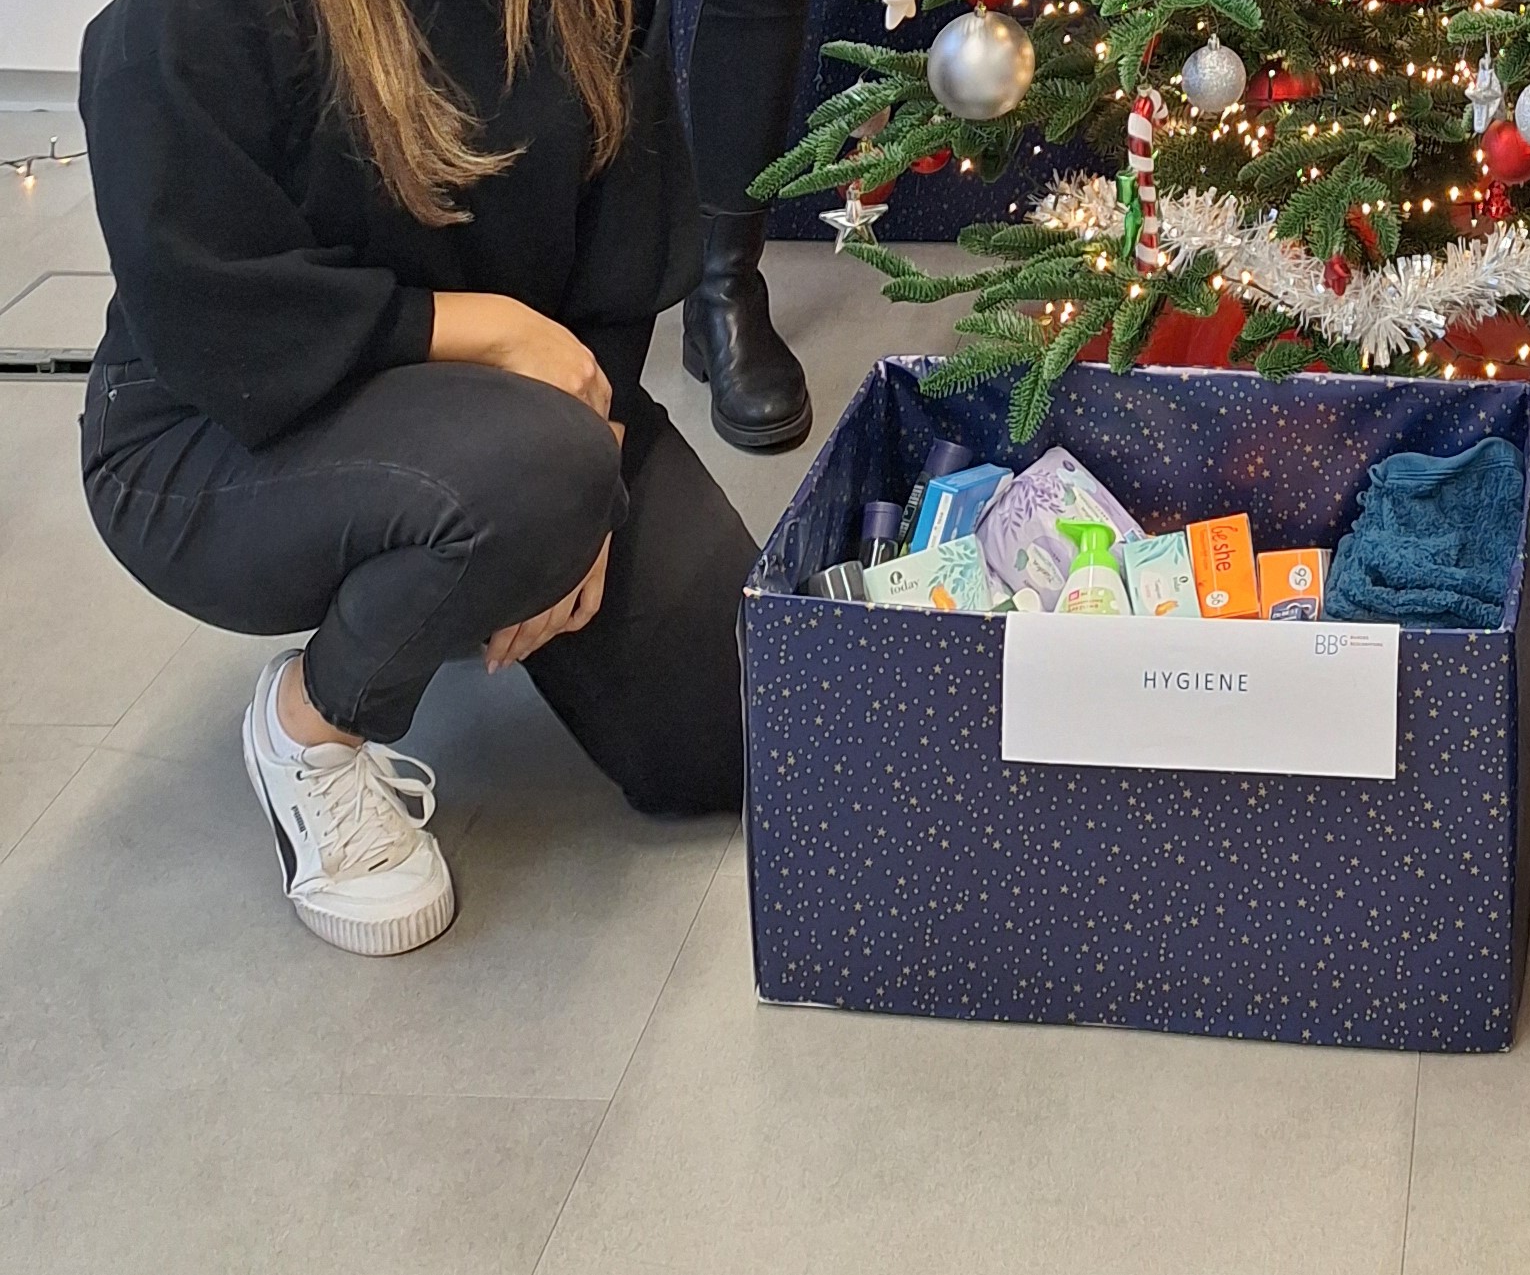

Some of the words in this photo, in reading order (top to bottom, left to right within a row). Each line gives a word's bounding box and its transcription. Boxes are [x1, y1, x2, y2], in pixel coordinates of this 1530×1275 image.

[1294, 567, 1308, 587] 56
[889, 579, 920, 596] today
[1210, 592, 1225, 606] 56
[1314, 634, 1348, 655] BBG
[1143, 671, 1249, 692] HYGIENE
